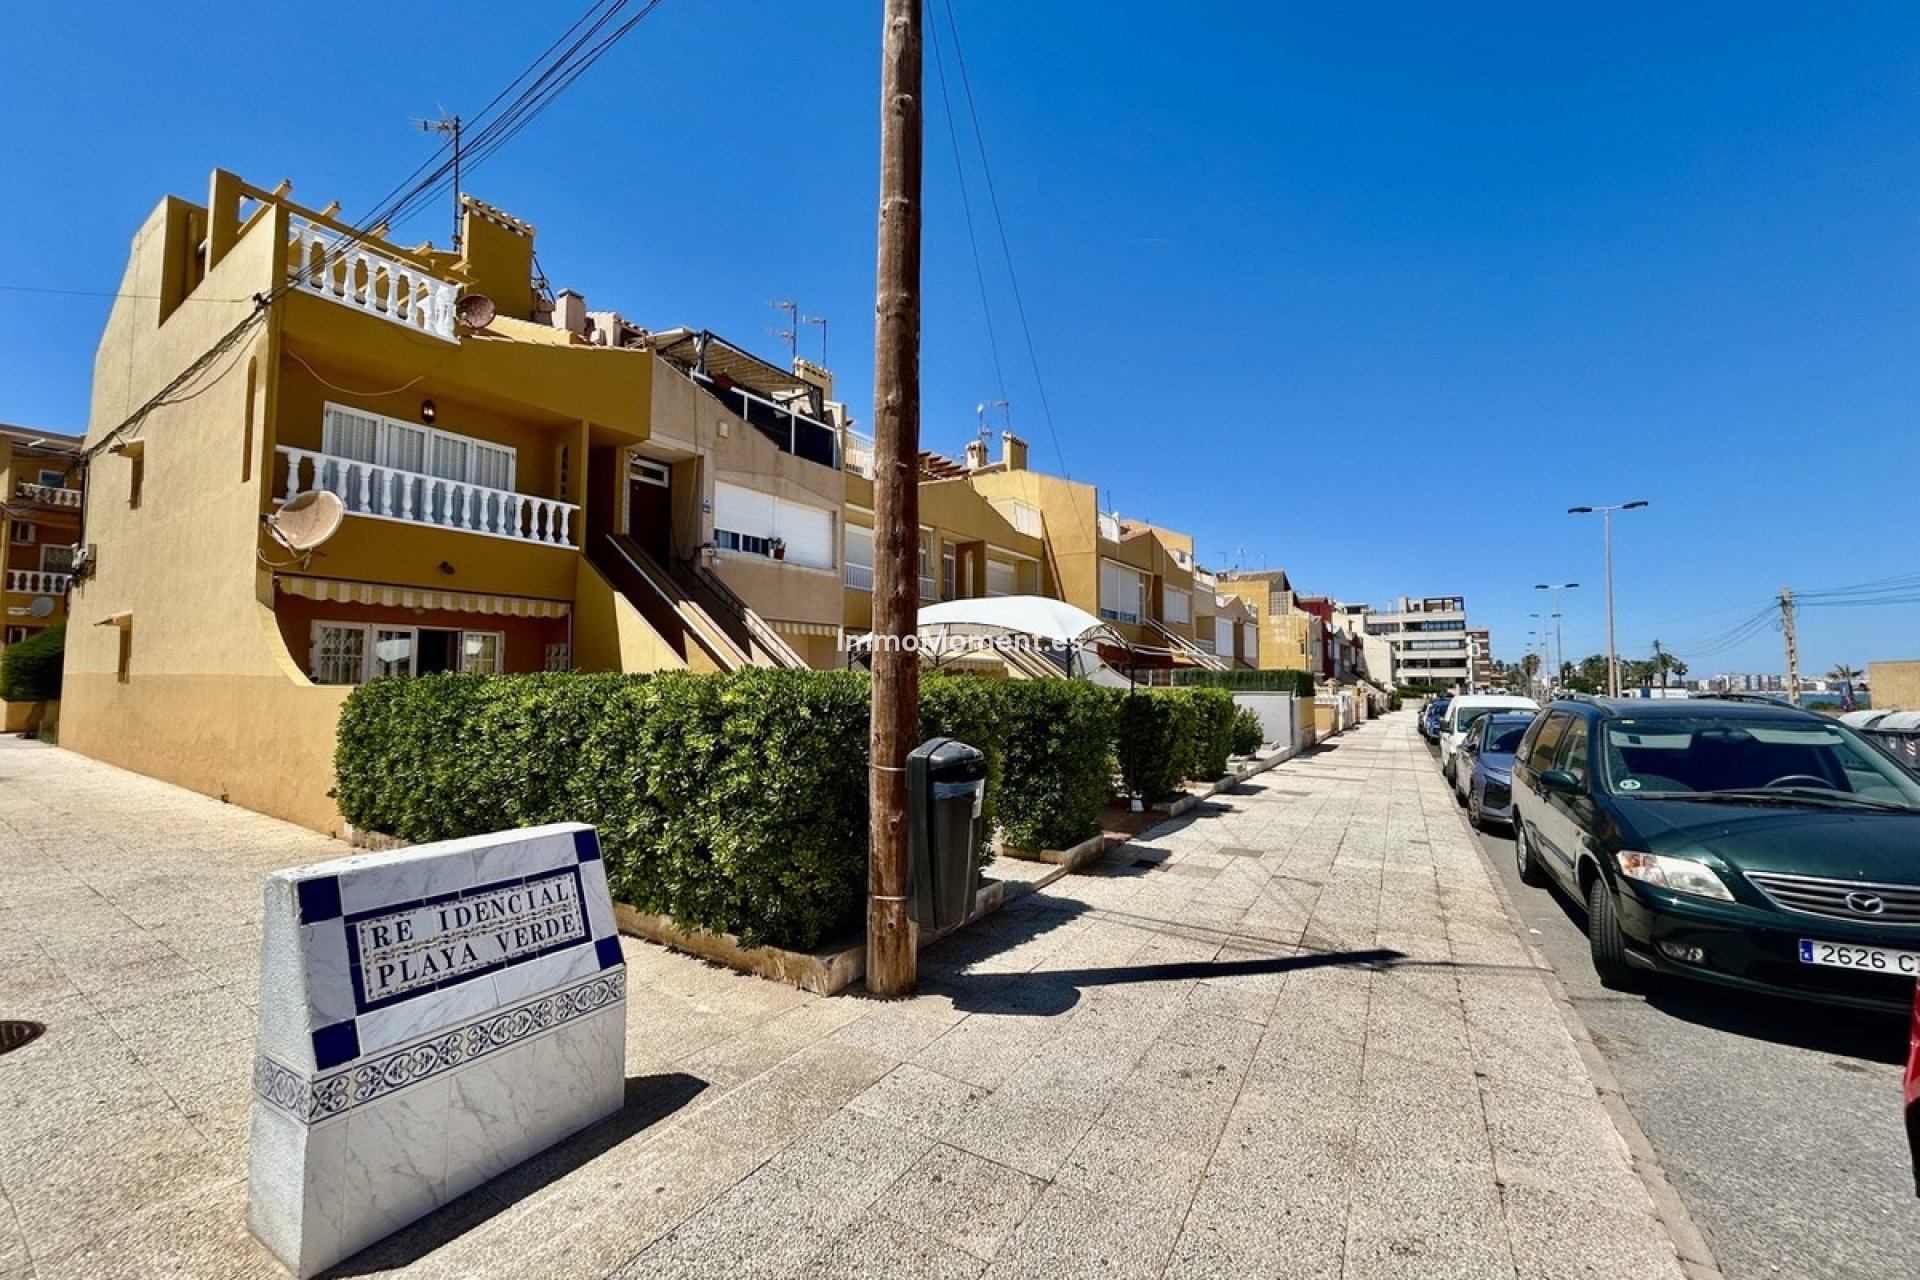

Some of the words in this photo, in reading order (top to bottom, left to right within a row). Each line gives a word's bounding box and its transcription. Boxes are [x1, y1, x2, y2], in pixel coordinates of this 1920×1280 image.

[378, 942, 478, 989] PLAYA
[496, 914, 576, 952] VERDE
[1821, 944, 1886, 969] 2626
[1898, 954, 1920, 973] C
